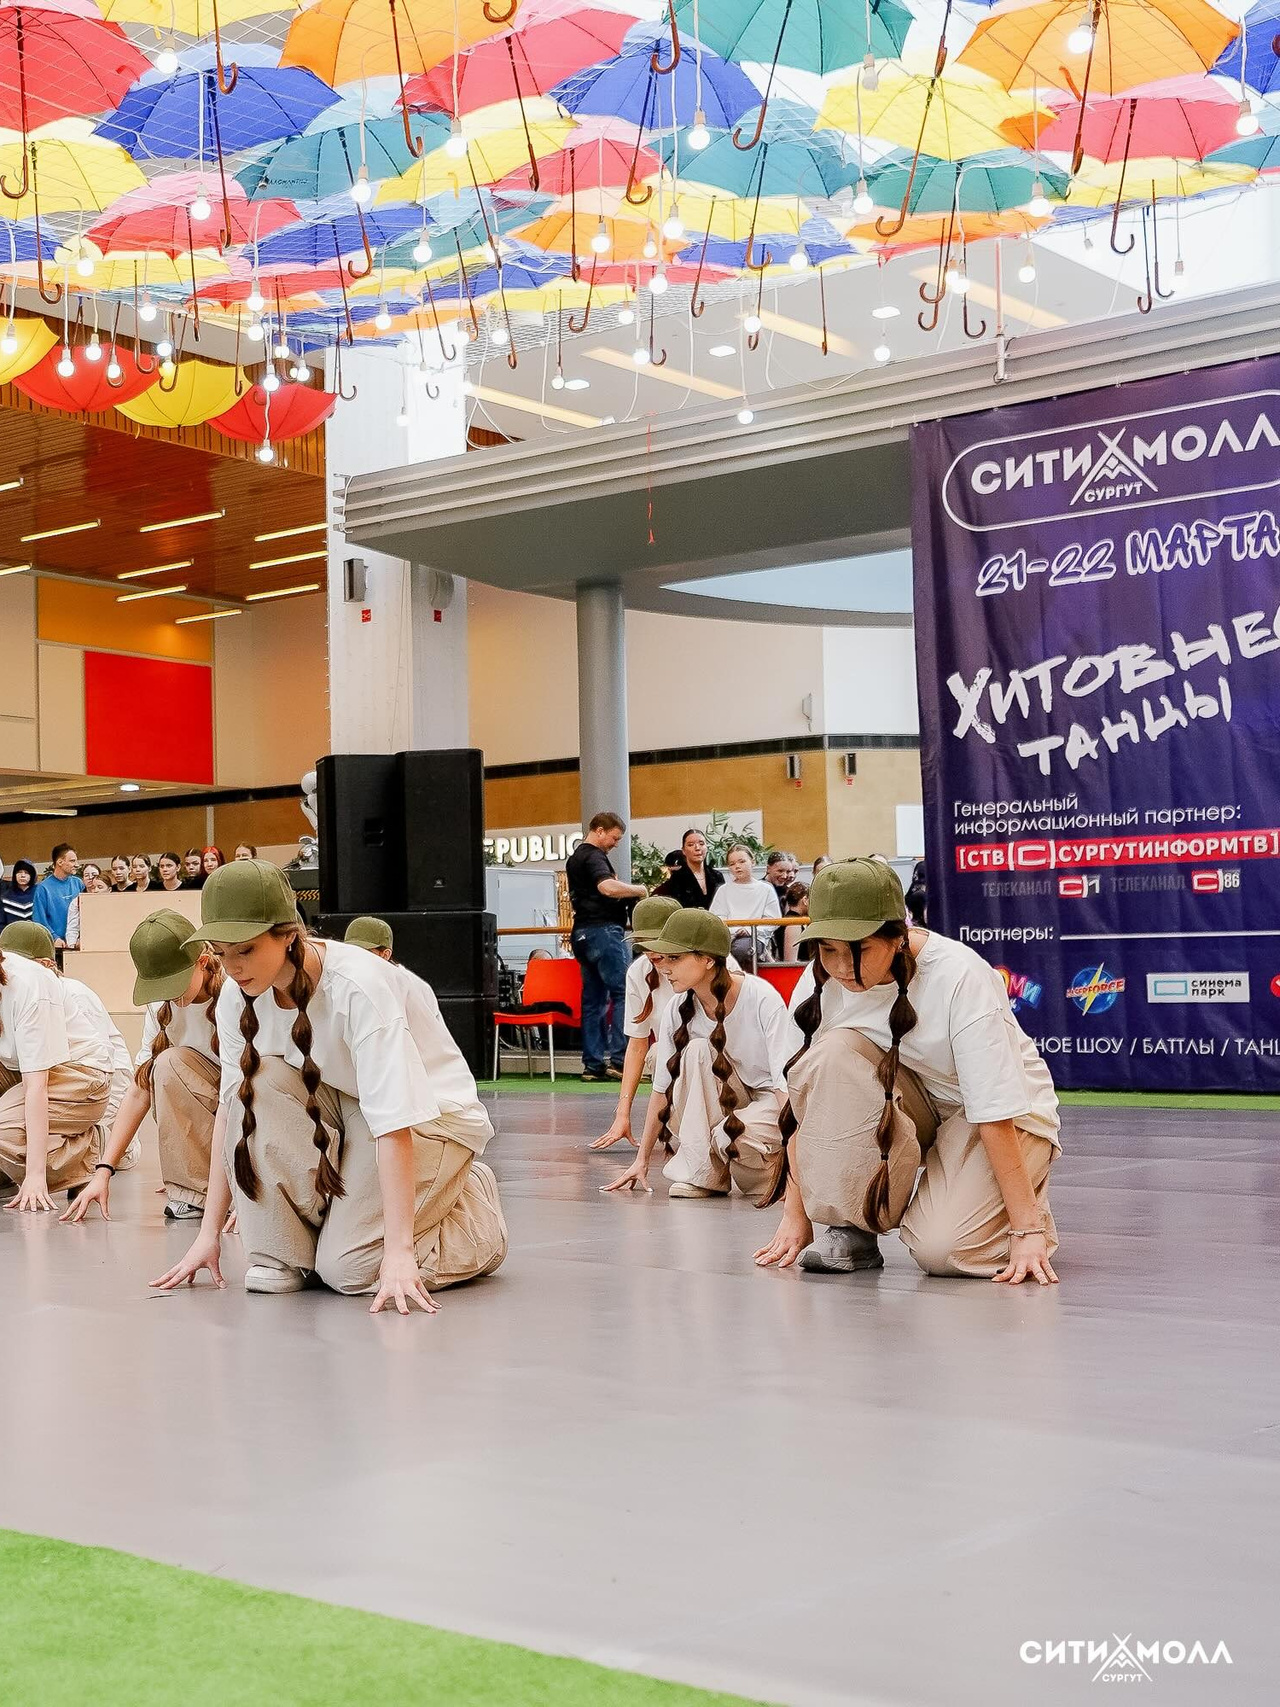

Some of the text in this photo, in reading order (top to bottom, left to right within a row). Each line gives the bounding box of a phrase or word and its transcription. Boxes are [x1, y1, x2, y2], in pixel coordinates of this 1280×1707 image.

[971, 413, 1280, 495] СИТИ МОЛЛ
[1084, 481, 1143, 503] СУРГУТ
[975, 510, 1280, 597] 21-22 МАРТА
[1017, 676, 1232, 776] ТАНЦЫ
[953, 792, 1079, 818] Генеральный
[954, 805, 1241, 837] информационный партнер:
[981, 879, 1052, 898] ТЕЛЕКАНАЛ
[1109, 874, 1186, 893] ТЕЛЕКАНАЛ
[959, 925, 1055, 945] Партнеры:
[1191, 980, 1242, 988] синема
[1191, 988, 1226, 999] парк
[1076, 1036, 1124, 1054] ШОУ
[1143, 1037, 1215, 1055] БАТТЛЫ
